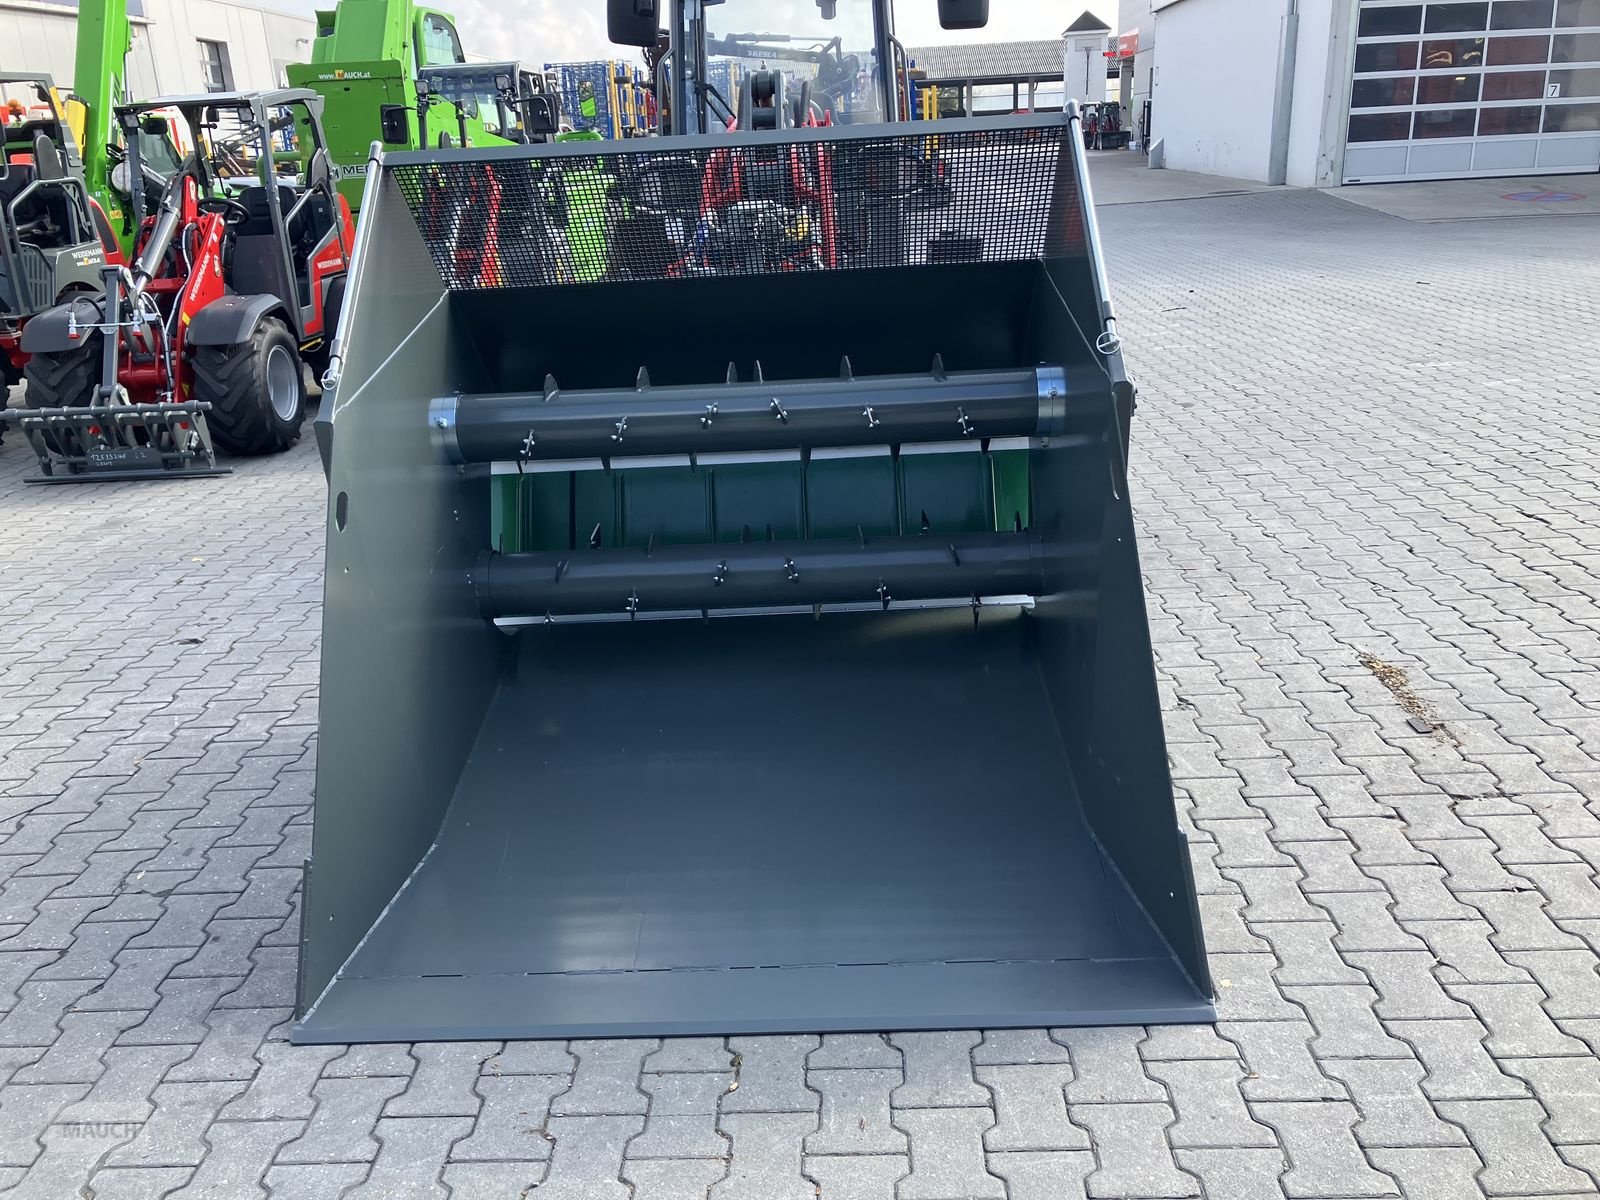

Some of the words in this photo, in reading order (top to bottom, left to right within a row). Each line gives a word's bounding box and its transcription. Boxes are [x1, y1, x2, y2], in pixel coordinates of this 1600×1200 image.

[318, 70, 371, 80] www.MAUCH.at
[1550, 85, 1558, 97] 7
[343, 164, 368, 175] ME
[71, 247, 104, 260] WEIDEMANN
[188, 251, 211, 302] WEIDEMANN
